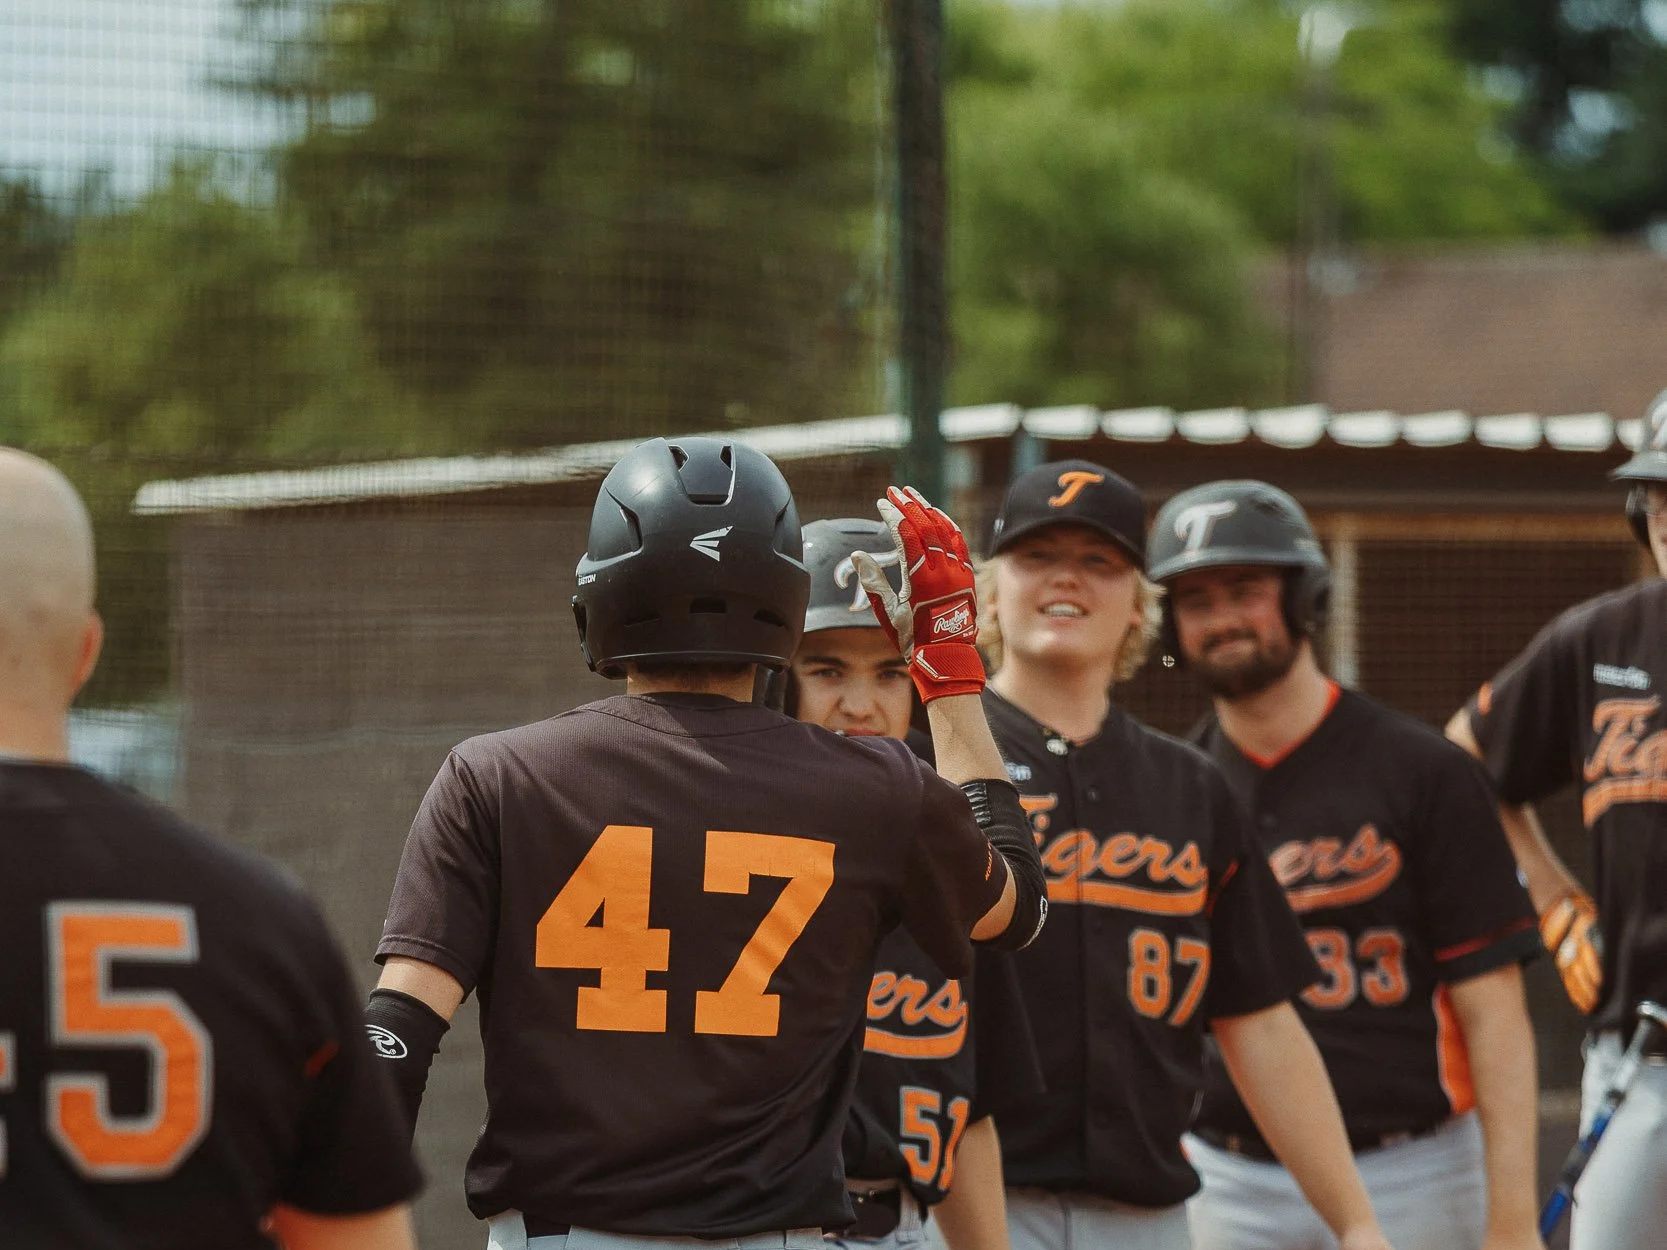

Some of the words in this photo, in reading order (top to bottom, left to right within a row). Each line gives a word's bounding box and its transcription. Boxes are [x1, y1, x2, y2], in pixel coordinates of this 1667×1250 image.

[1174, 500, 1237, 558] T
[933, 608, 970, 634] Rawlings
[1268, 822, 1385, 887] ers
[535, 825, 836, 1037] 47
[1301, 925, 1409, 1010] 33
[867, 971, 967, 1028] ers
[1127, 927, 1211, 1027] 87
[0, 900, 214, 1181] 5
